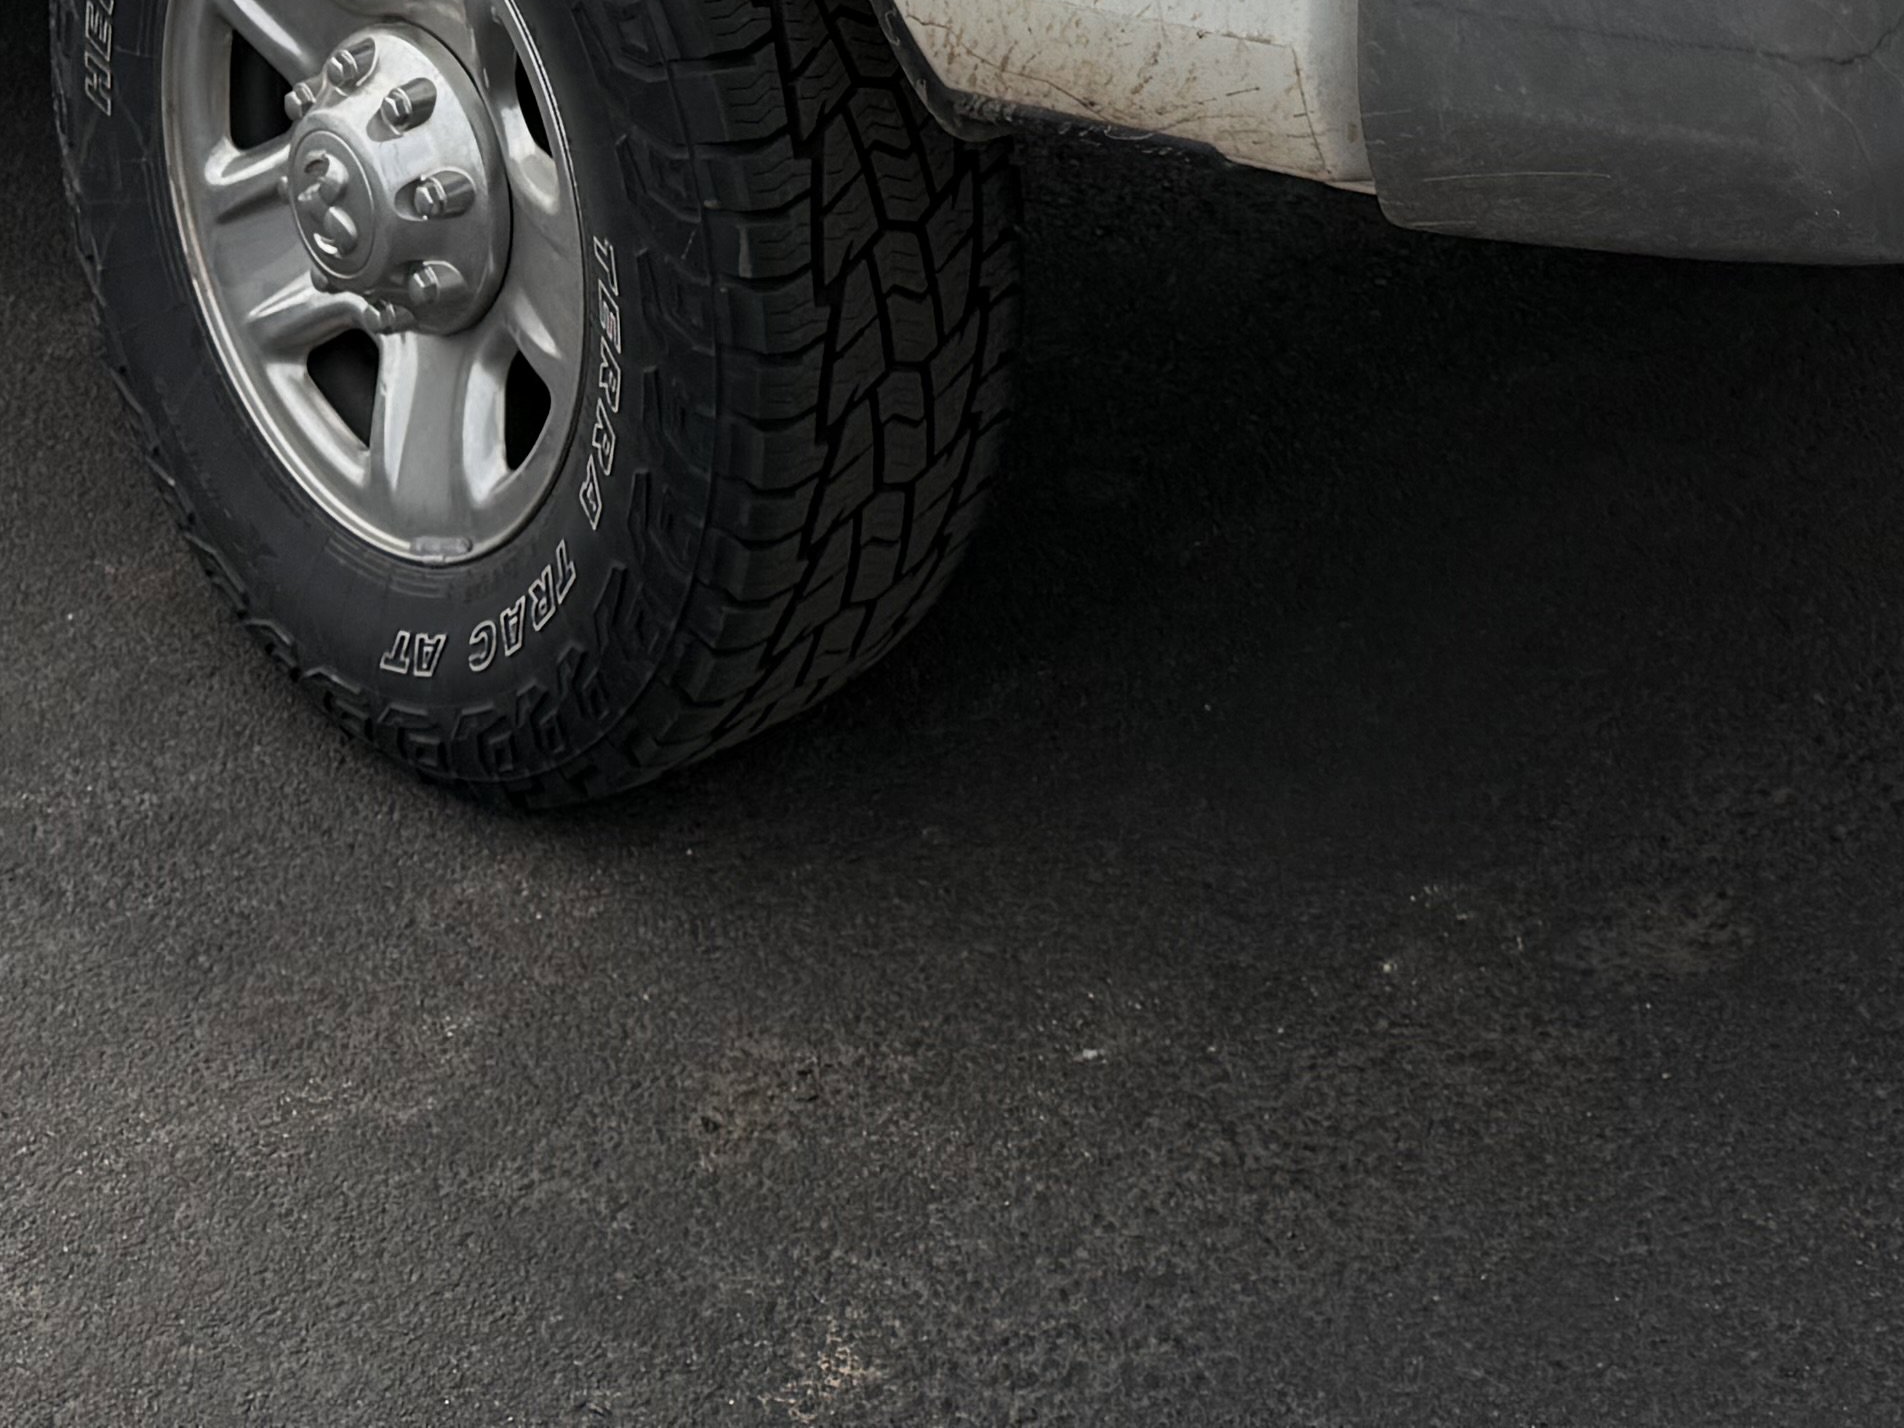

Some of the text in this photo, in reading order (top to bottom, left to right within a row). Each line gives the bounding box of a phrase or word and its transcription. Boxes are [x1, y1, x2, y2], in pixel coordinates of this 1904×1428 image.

[379, 235, 624, 677] TERRA TRAC AT
